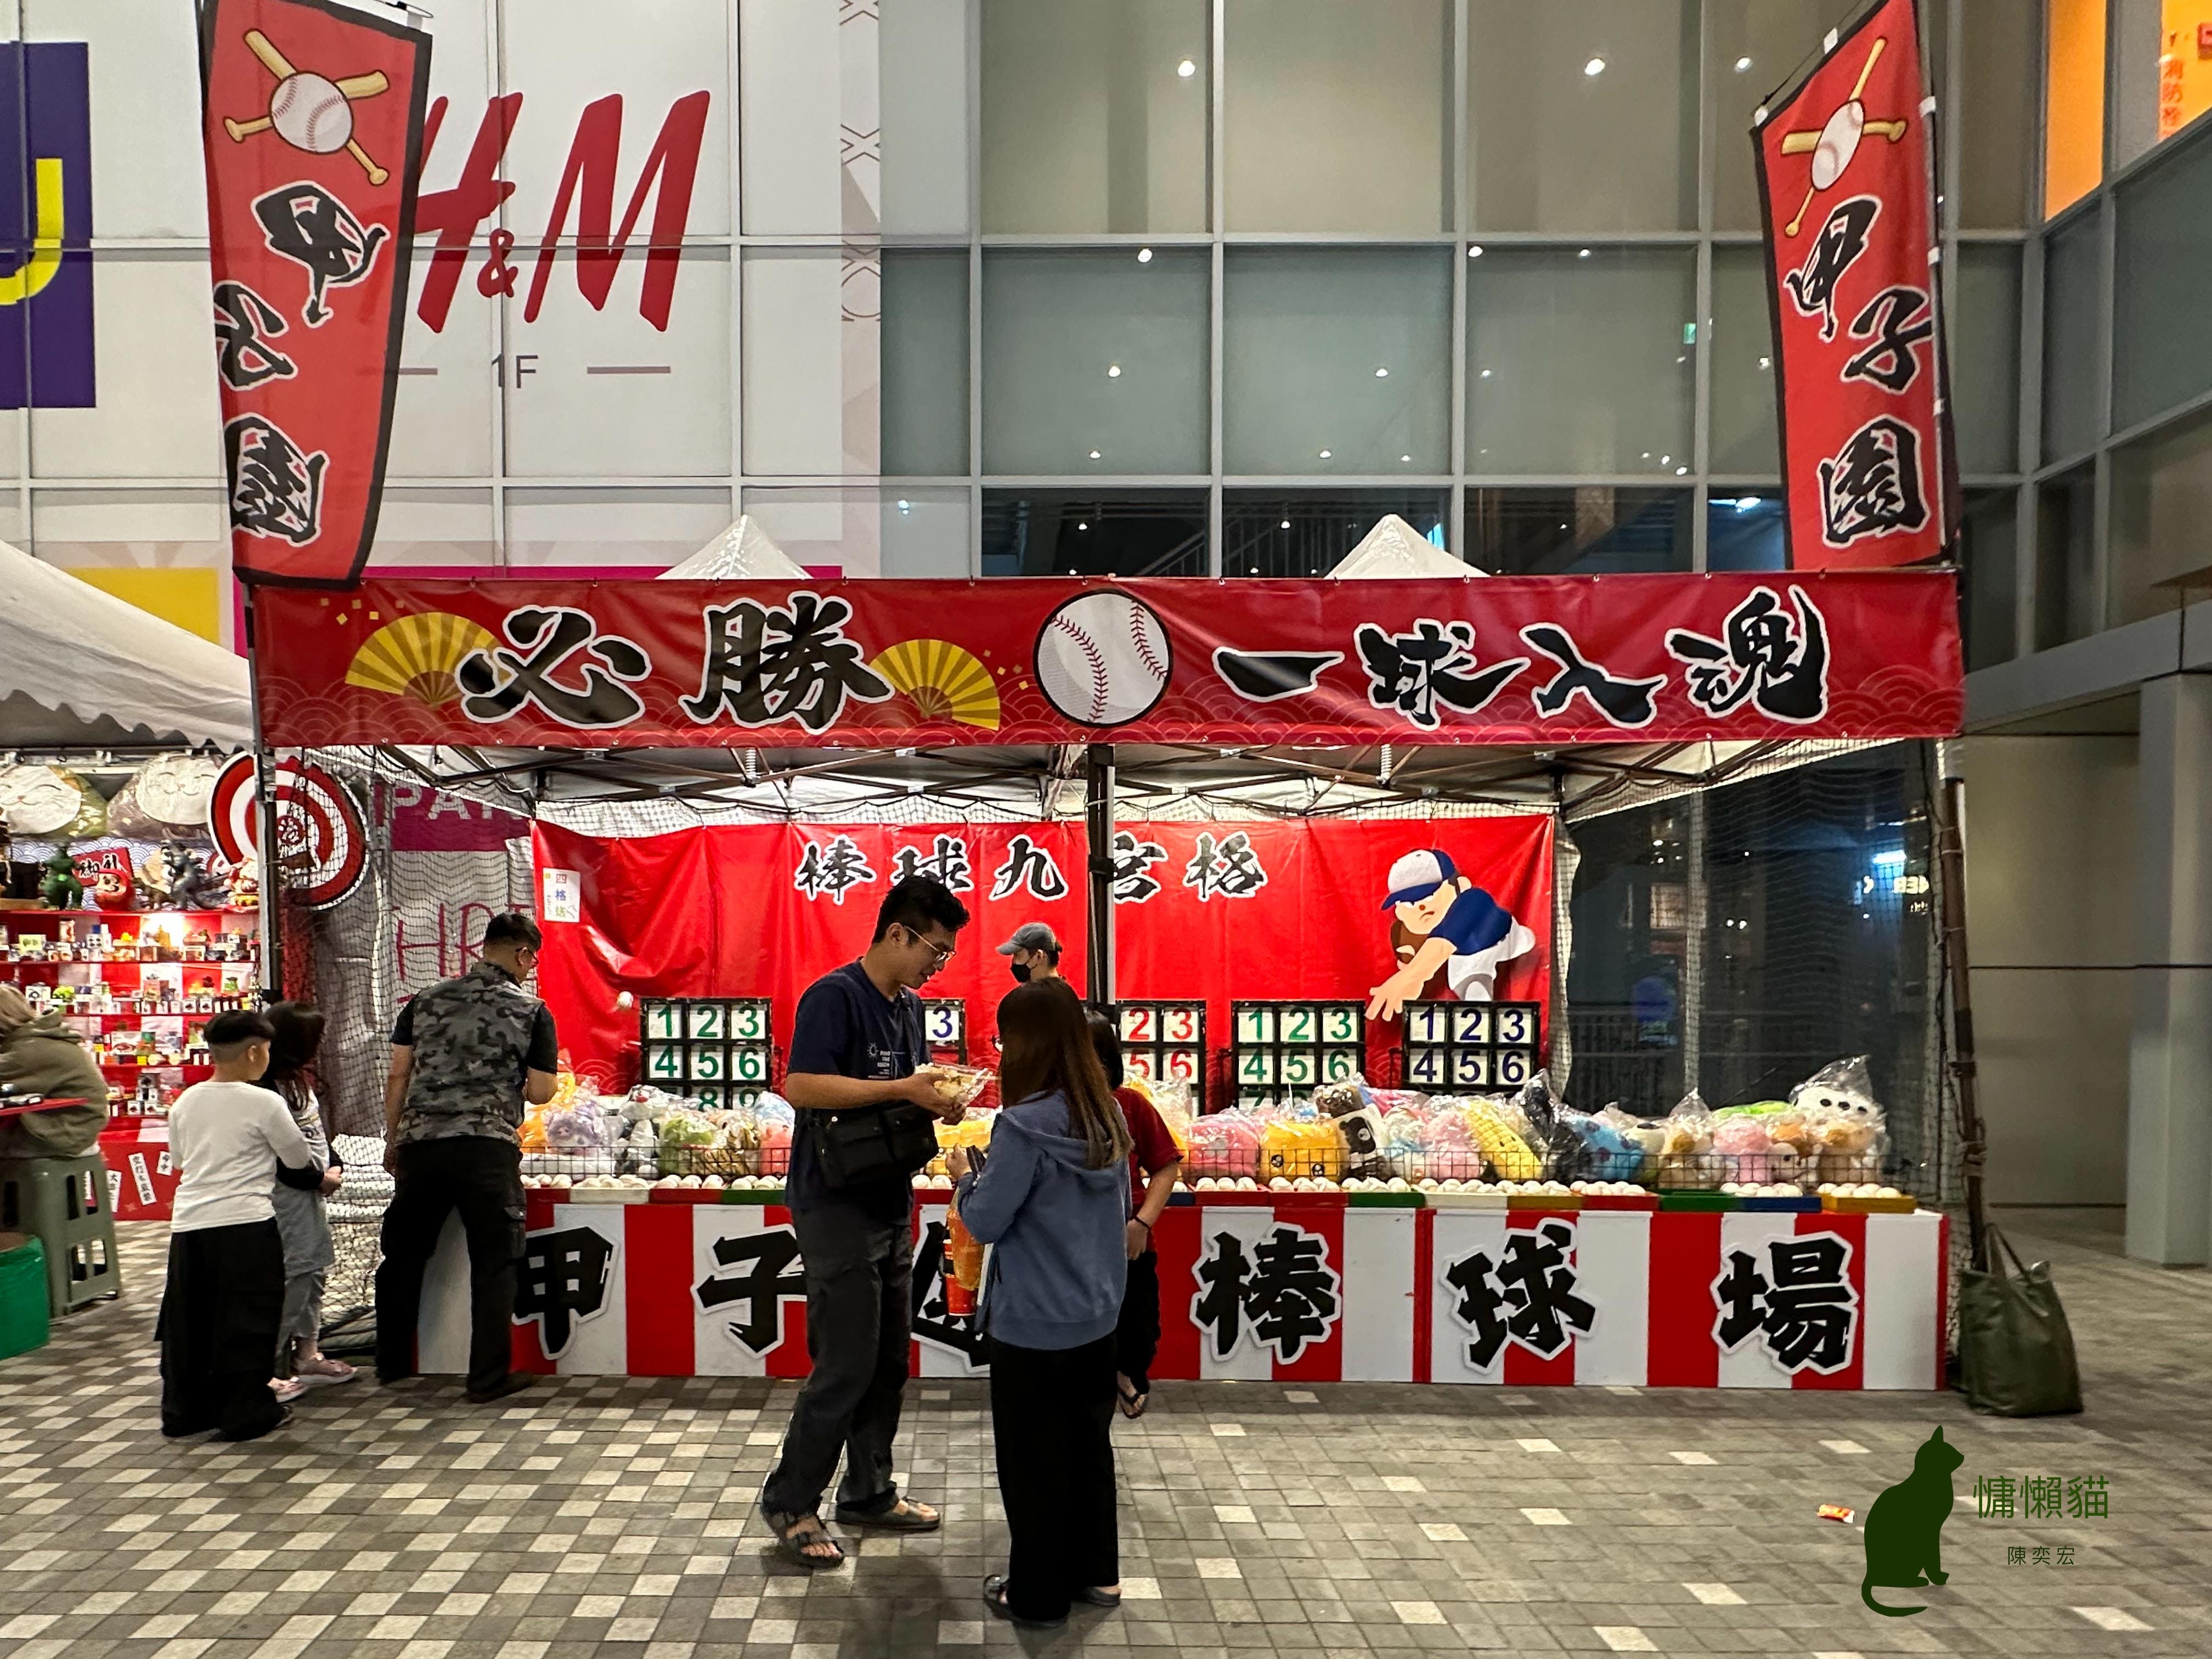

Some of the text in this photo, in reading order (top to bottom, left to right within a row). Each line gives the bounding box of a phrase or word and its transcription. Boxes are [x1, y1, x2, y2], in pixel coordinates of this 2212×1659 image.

[415, 91, 710, 334] H&M
[491, 353, 539, 389] 1F
[1784, 195, 1933, 549] 甲子園
[457, 585, 1831, 735] 必勝 一球入魂
[658, 1005, 759, 1038] 1 2 3
[932, 1006, 952, 1039] 3
[1128, 1007, 1193, 1040] 2 3
[1248, 1008, 1352, 1040] 1 2 3
[1419, 1007, 1525, 1041] 1 2 3
[654, 1046, 760, 1080] 4 5 6
[1130, 1048, 1192, 1079] 5 6
[1244, 1049, 1350, 1082] 4 5 6
[1413, 1049, 1524, 1083] 4 5 6
[698, 1087, 718, 1112] 8
